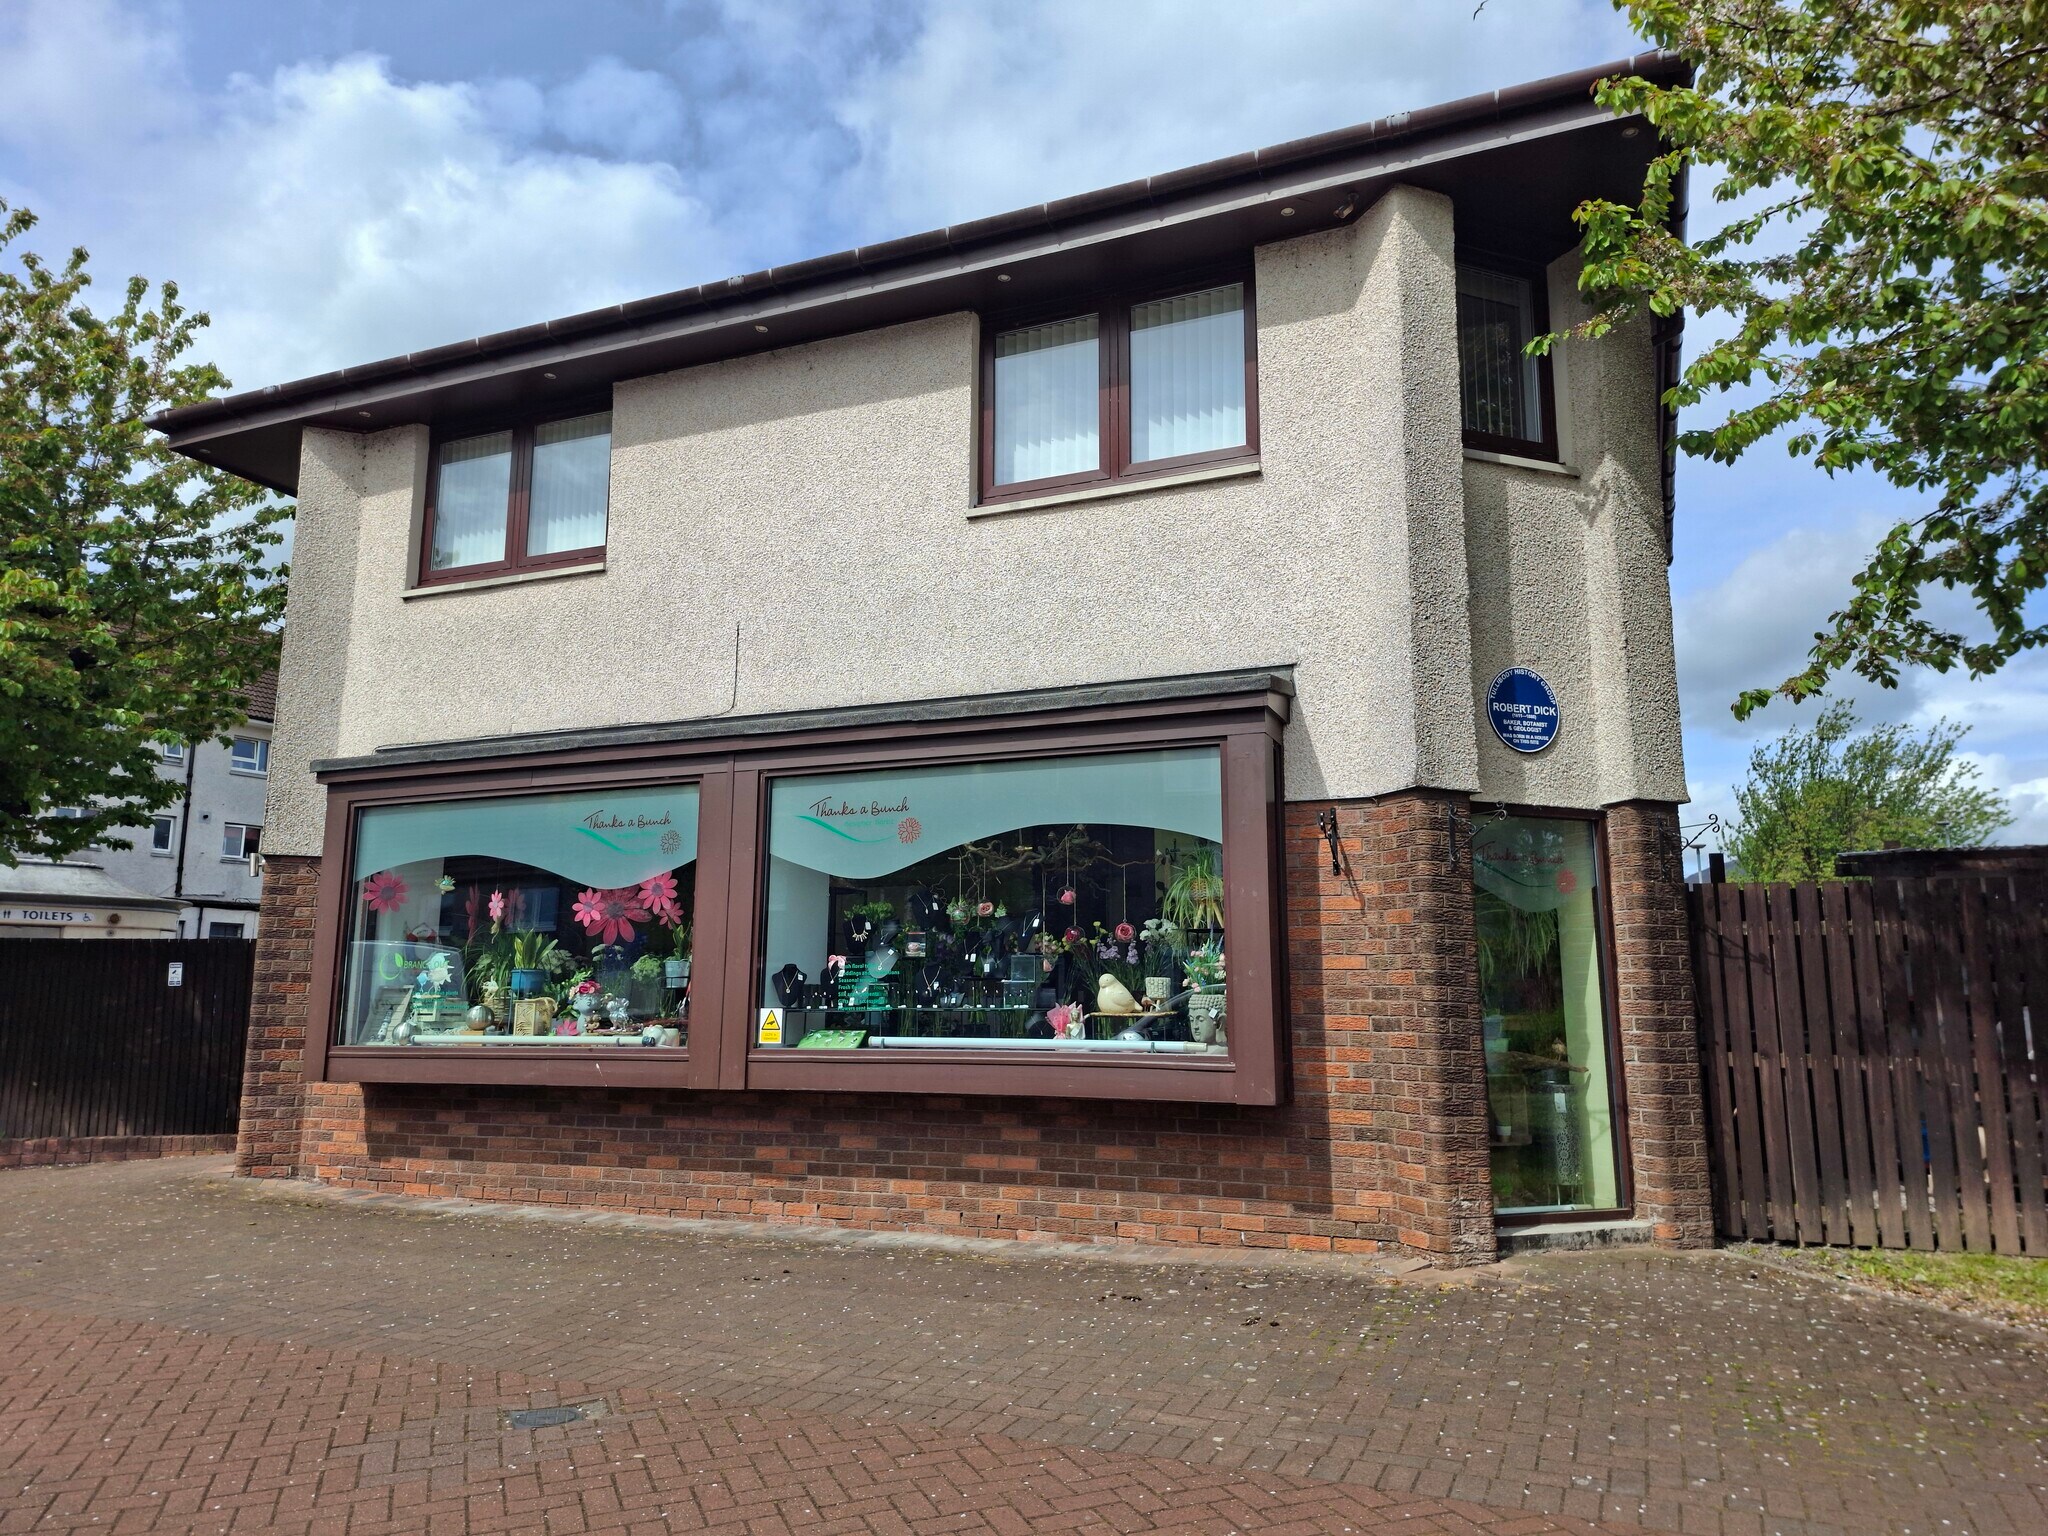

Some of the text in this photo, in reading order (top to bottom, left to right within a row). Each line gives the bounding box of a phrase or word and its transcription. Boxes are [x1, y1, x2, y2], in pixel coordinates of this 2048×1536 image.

[1490, 668, 1556, 705] TULLIBODY HISTORY GROUP
[1492, 702, 1557, 717] ROBERT DICK
[1522, 720, 1548, 728] BOTANIST
[809, 796, 910, 818] Thanks a Bunch
[583, 809, 671, 829] Thanks a Bunch
[22, 910, 73, 921] TOILETS
[403, 960, 428, 969] BRANC
